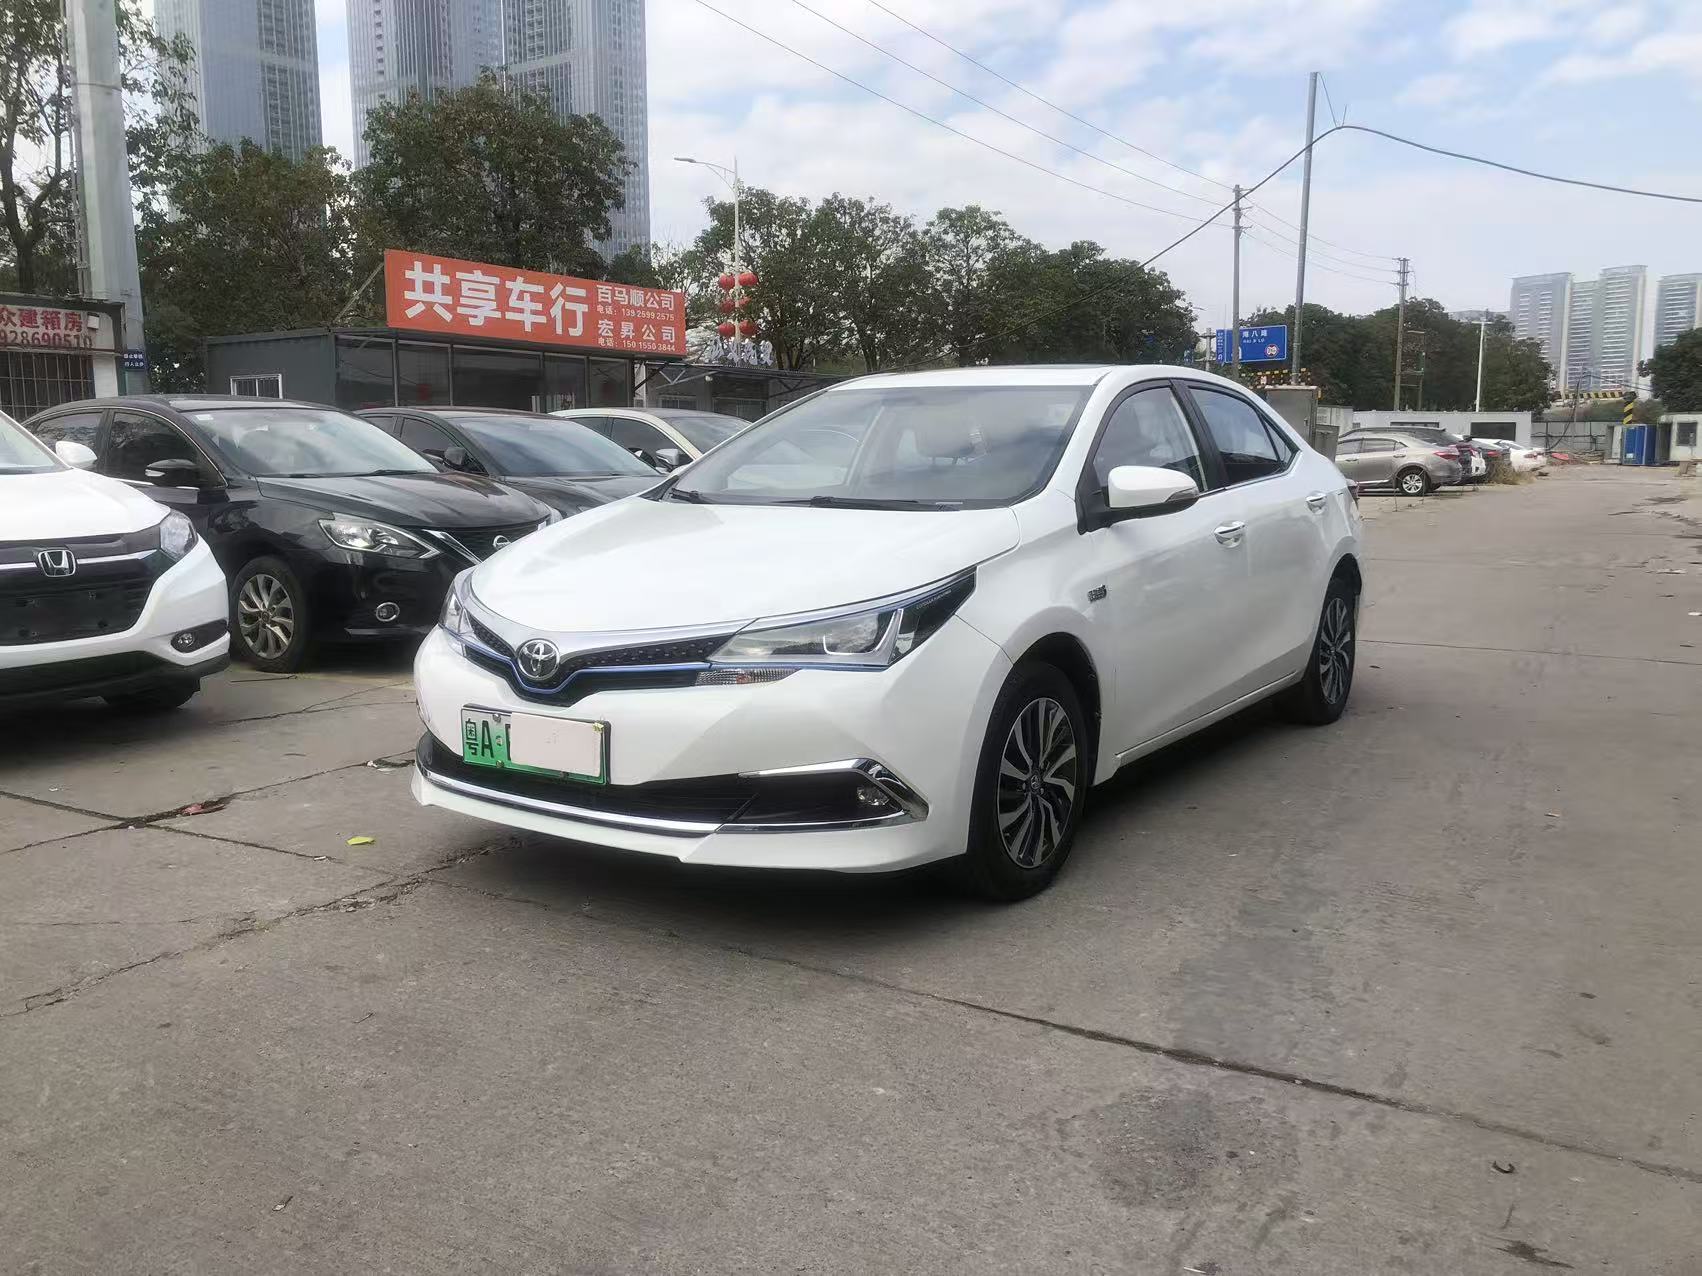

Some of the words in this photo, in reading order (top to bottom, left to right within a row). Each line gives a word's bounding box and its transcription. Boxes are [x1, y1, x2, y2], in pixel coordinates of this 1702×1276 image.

[404, 261, 588, 336] 共享车行
[597, 284, 674, 311] 百马顺公司
[598, 319, 675, 343] 宏昇公司
[465, 718, 511, 762] 粤A
